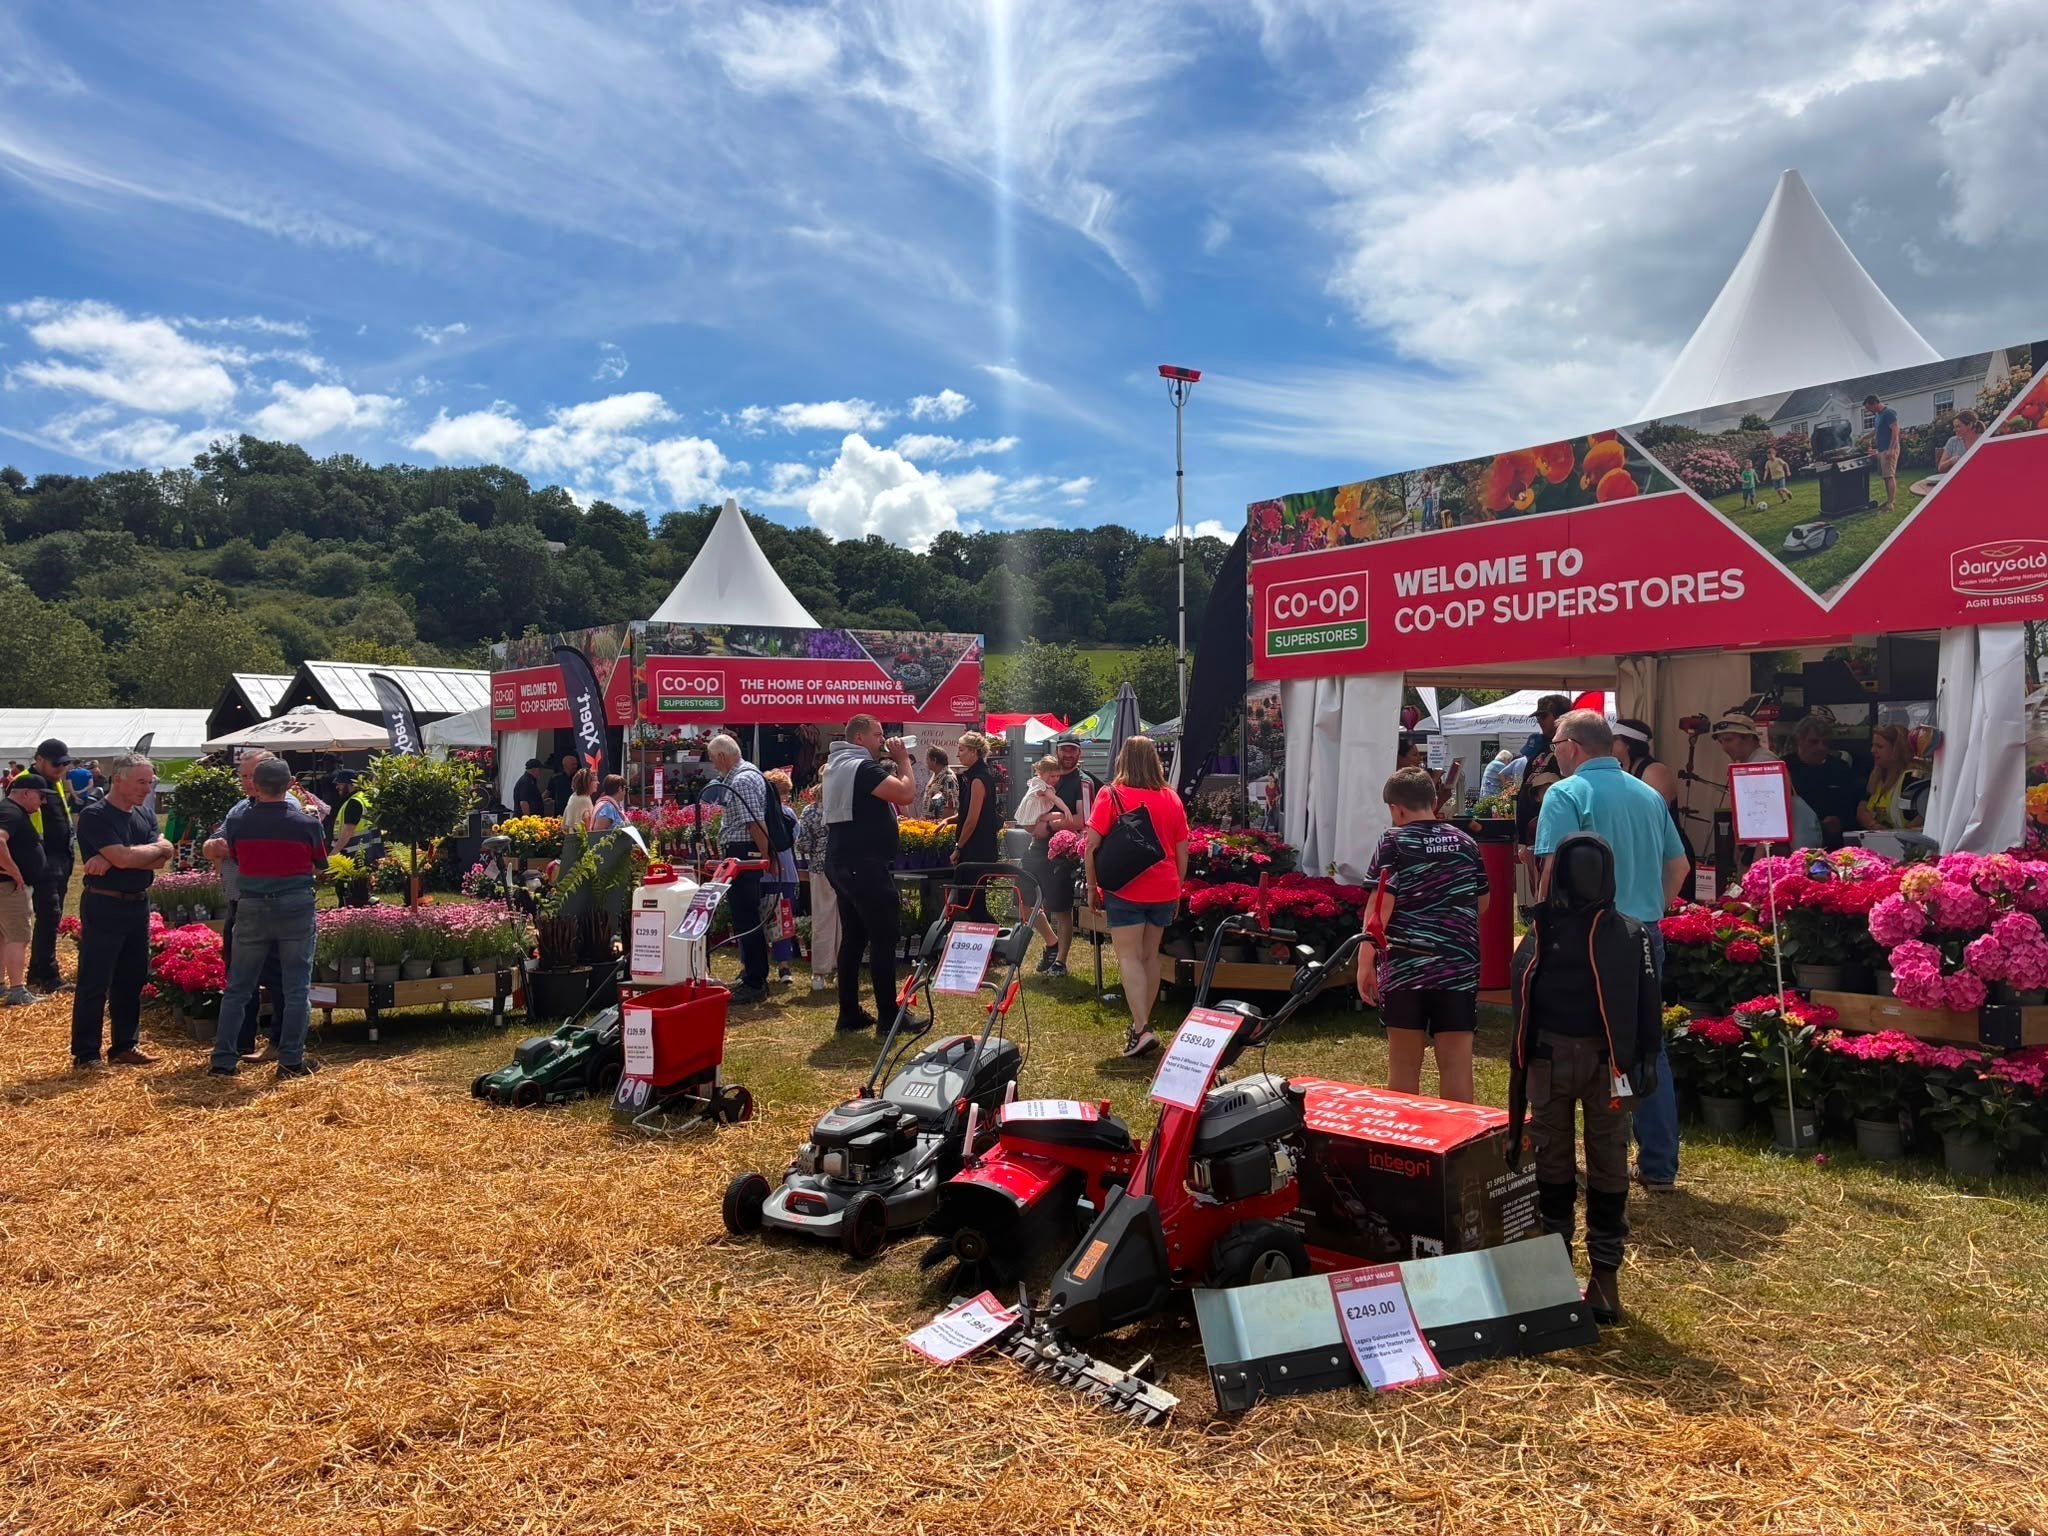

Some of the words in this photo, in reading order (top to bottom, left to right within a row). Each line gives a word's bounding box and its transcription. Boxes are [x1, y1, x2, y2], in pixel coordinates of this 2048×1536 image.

[1394, 554, 1527, 597] WELOME
[1536, 548, 1583, 579] TO
[1958, 552, 2047, 577] dairygold
[1394, 599, 1485, 634] CO-OP
[1494, 568, 1746, 624] SUPERSTORES
[1966, 599, 1990, 608] AGRI
[1993, 594, 2044, 606] BUSINESS
[1275, 628, 1358, 648] SUPERSTORES
[520, 683, 546, 698] WELOME
[548, 681, 557, 694] TO
[740, 679, 764, 690] THE
[768, 679, 804, 690] HOME
[807, 679, 823, 690] OF
[825, 680, 892, 691] GARDENING
[895, 680, 903, 691] &
[520, 700, 540, 713] CO-OP
[663, 699, 720, 707] SUPERSTORES
[741, 694, 803, 705] OUTDOOR
[806, 694, 844, 705] LIVING
[848, 694, 860, 705] IN
[862, 694, 915, 705] MUNSTER
[577, 692, 601, 749] Xpert
[391, 711, 415, 755] Xpert
[1423, 836, 1459, 845] SPORTS
[1426, 844, 1461, 853] DIRECT
[951, 941, 983, 951] €399.00
[1180, 1032, 1215, 1049] €589.00
[1350, 1104, 1399, 1118] SPES
[1360, 1117, 1423, 1132] START
[1357, 1127, 1440, 1147] MOWER
[1369, 1148, 1431, 1178] integri
[1354, 1275, 1374, 1283] GREAT
[1375, 1270, 1395, 1280] VALUE
[1346, 1300, 1396, 1321] €249.00
